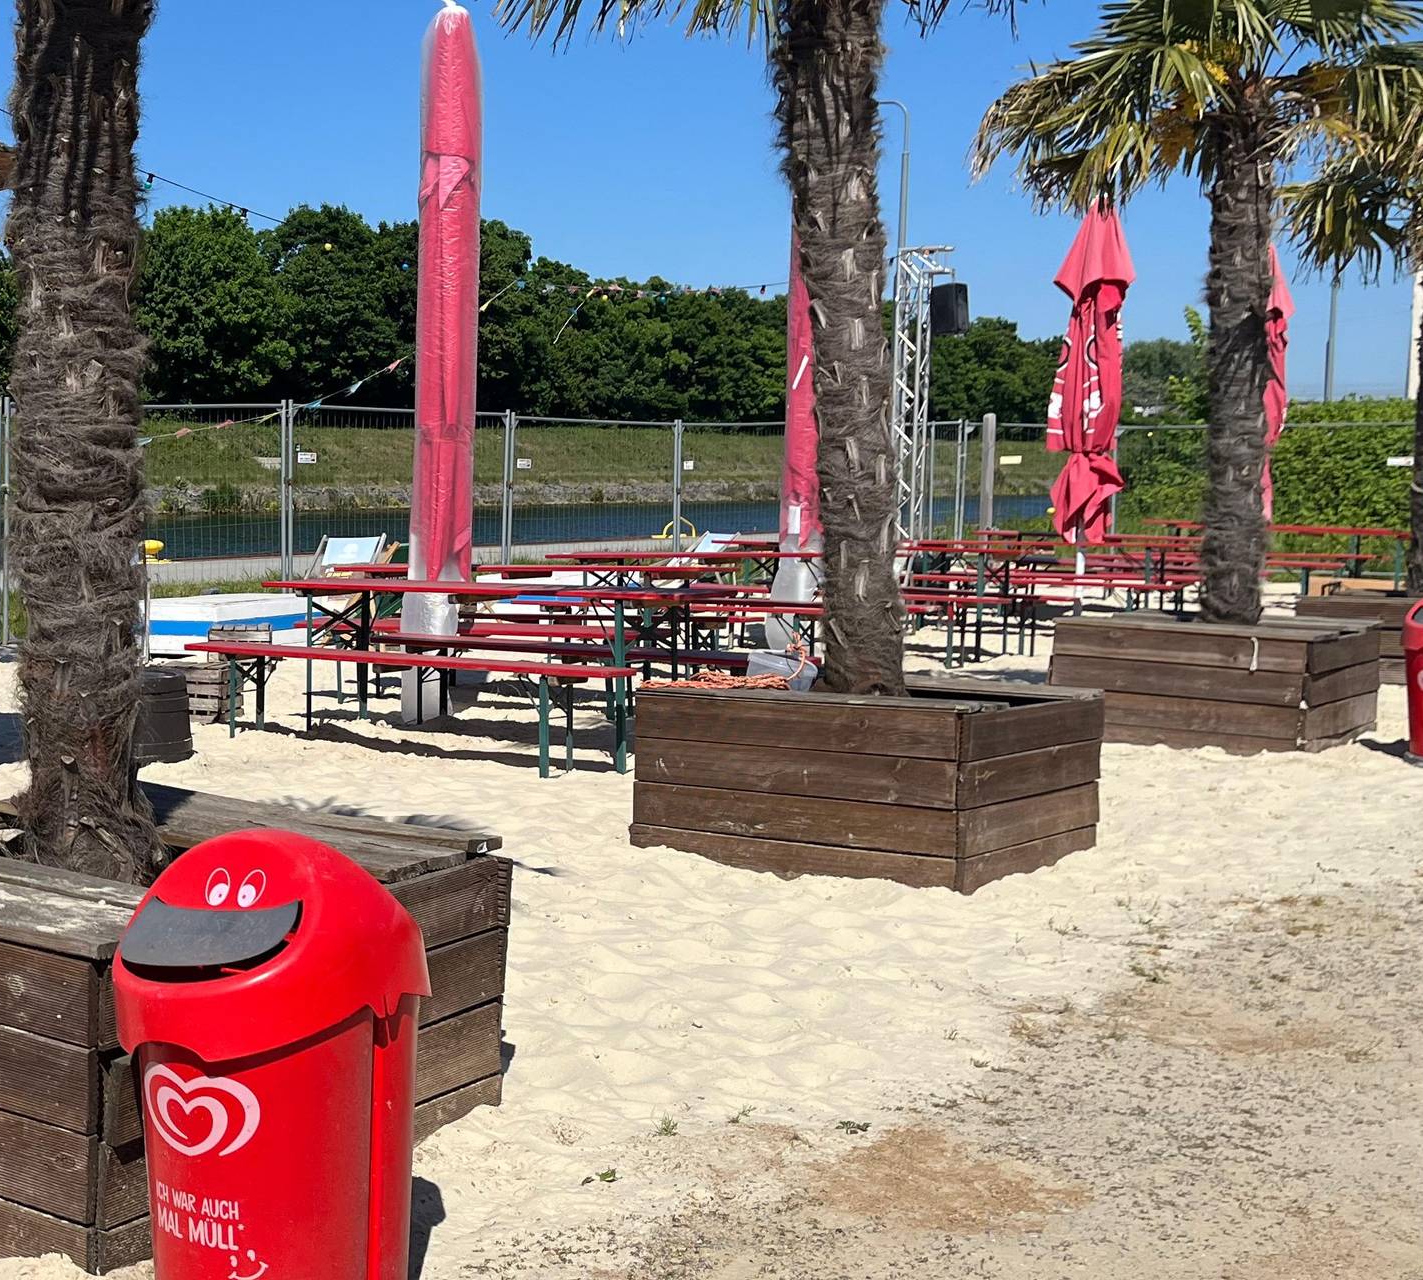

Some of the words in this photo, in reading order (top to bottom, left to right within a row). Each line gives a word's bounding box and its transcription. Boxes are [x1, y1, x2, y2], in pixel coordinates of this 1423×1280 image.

[156, 1180, 169, 1205] ICH
[171, 1189, 197, 1214] WAR
[201, 1198, 240, 1220] AUCH
[157, 1203, 183, 1239] MAL
